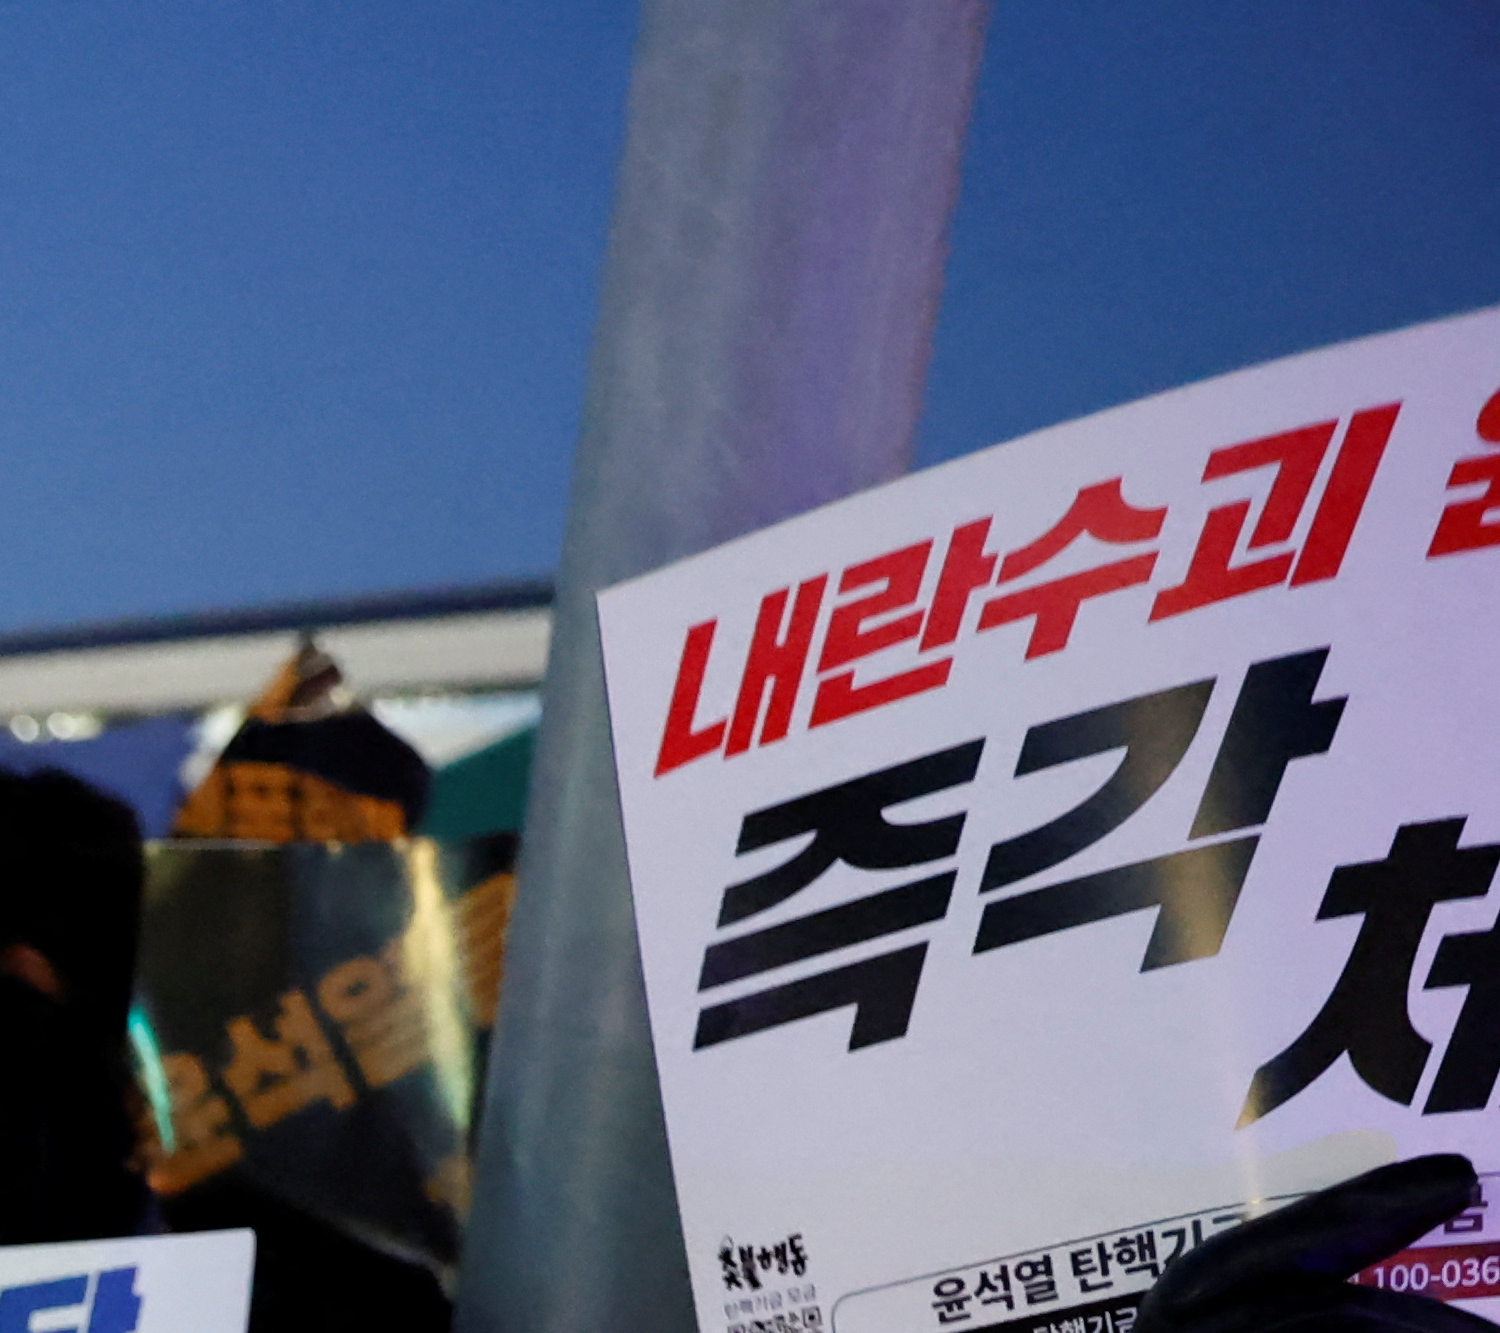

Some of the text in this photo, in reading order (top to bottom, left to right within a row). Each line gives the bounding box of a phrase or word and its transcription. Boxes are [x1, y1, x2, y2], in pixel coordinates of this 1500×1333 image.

[653, 401, 1403, 780] 내란수괴
[692, 645, 1349, 1053] 즉각
[931, 1212, 1245, 1325] 윤석열 탄핵기
